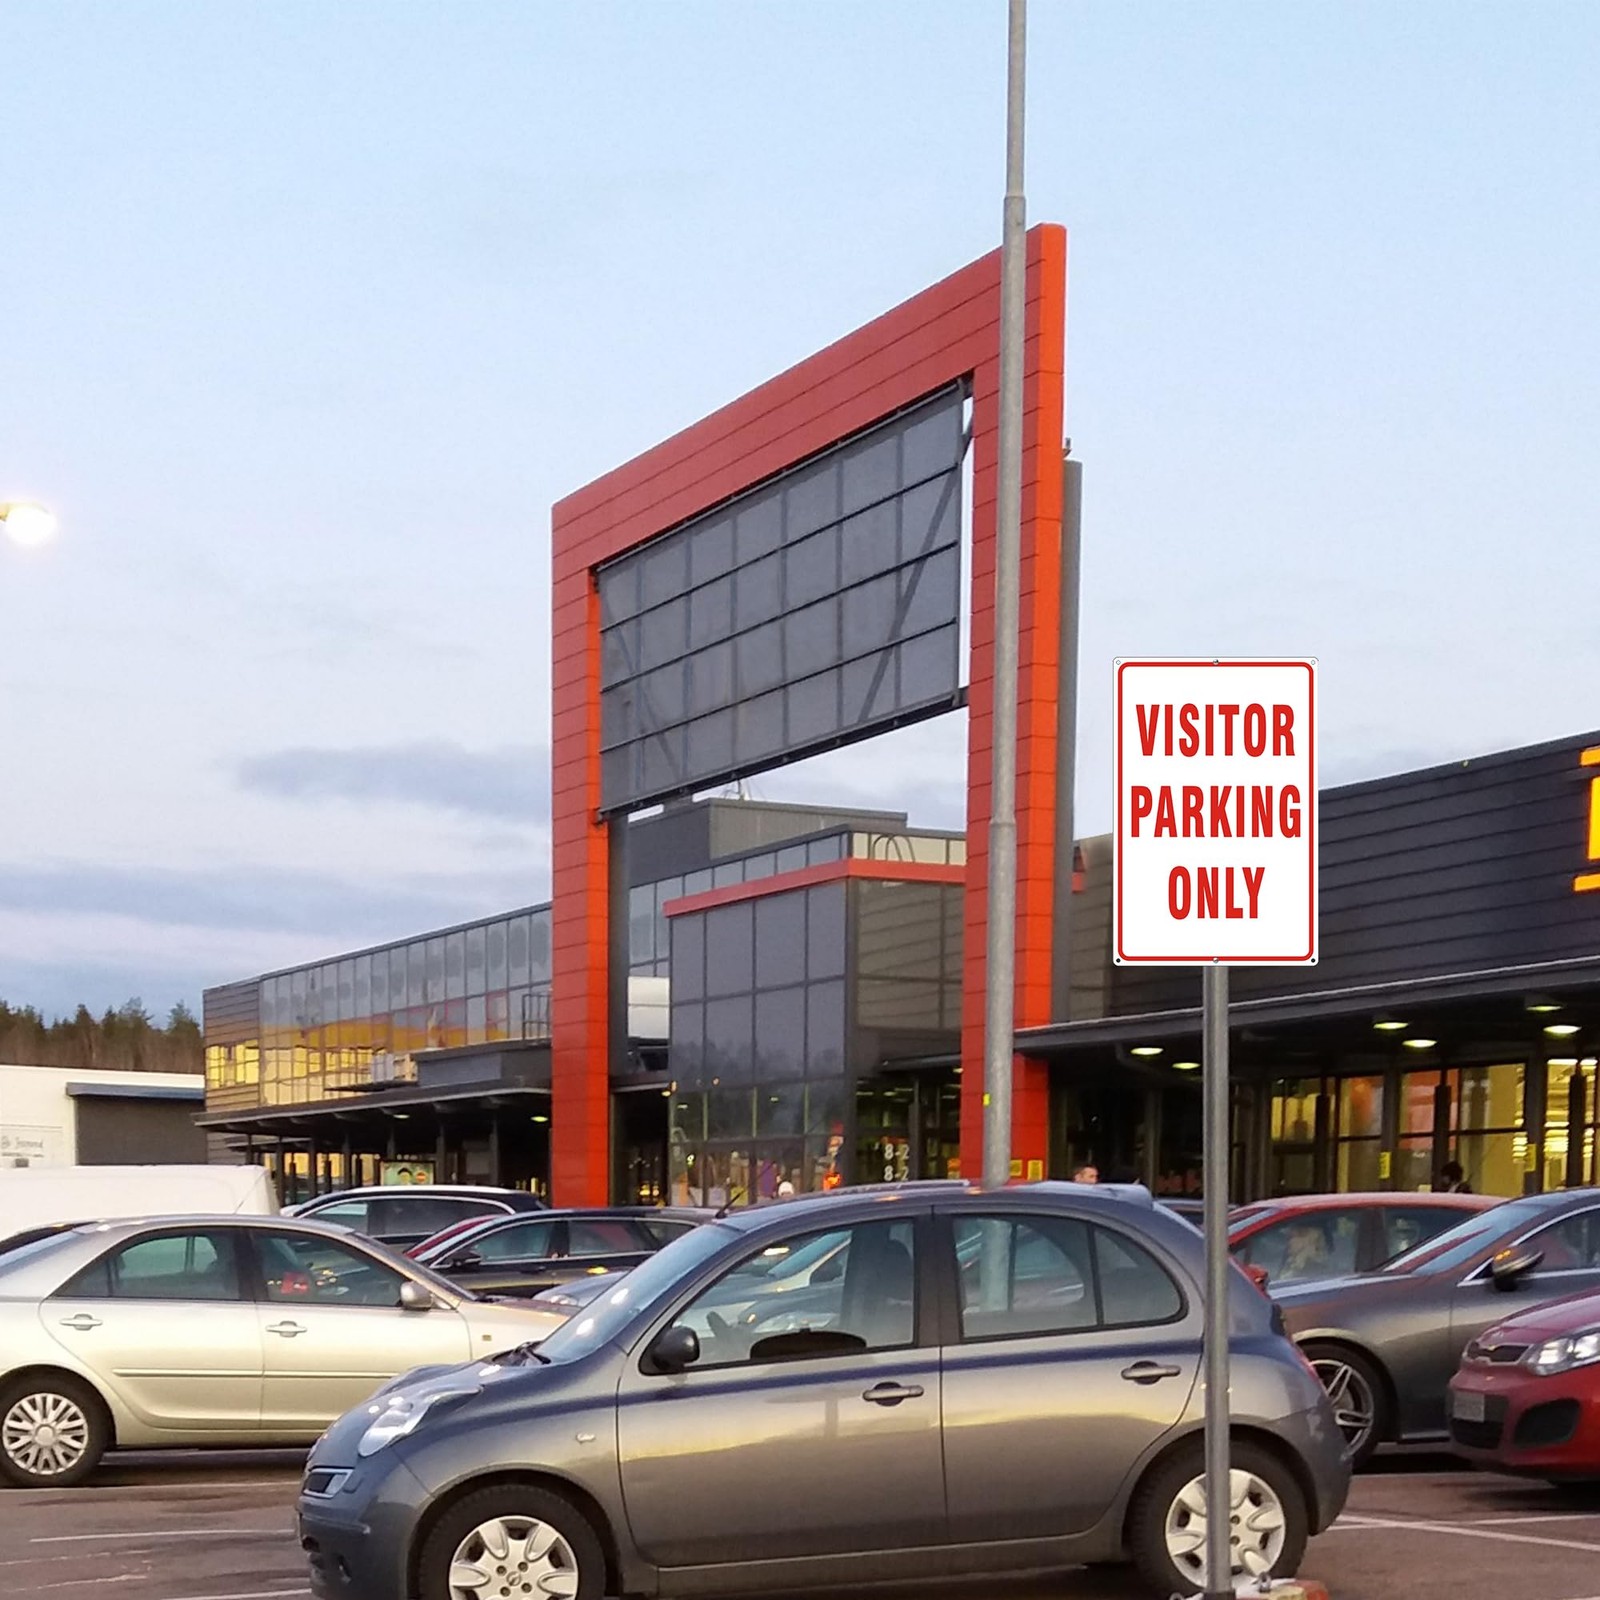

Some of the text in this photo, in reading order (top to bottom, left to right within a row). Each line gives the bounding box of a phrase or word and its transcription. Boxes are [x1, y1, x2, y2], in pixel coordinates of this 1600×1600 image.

[1135, 703, 1295, 758] VISITOR
[1130, 784, 1302, 839] PARKING
[1167, 865, 1265, 920] ONLY
